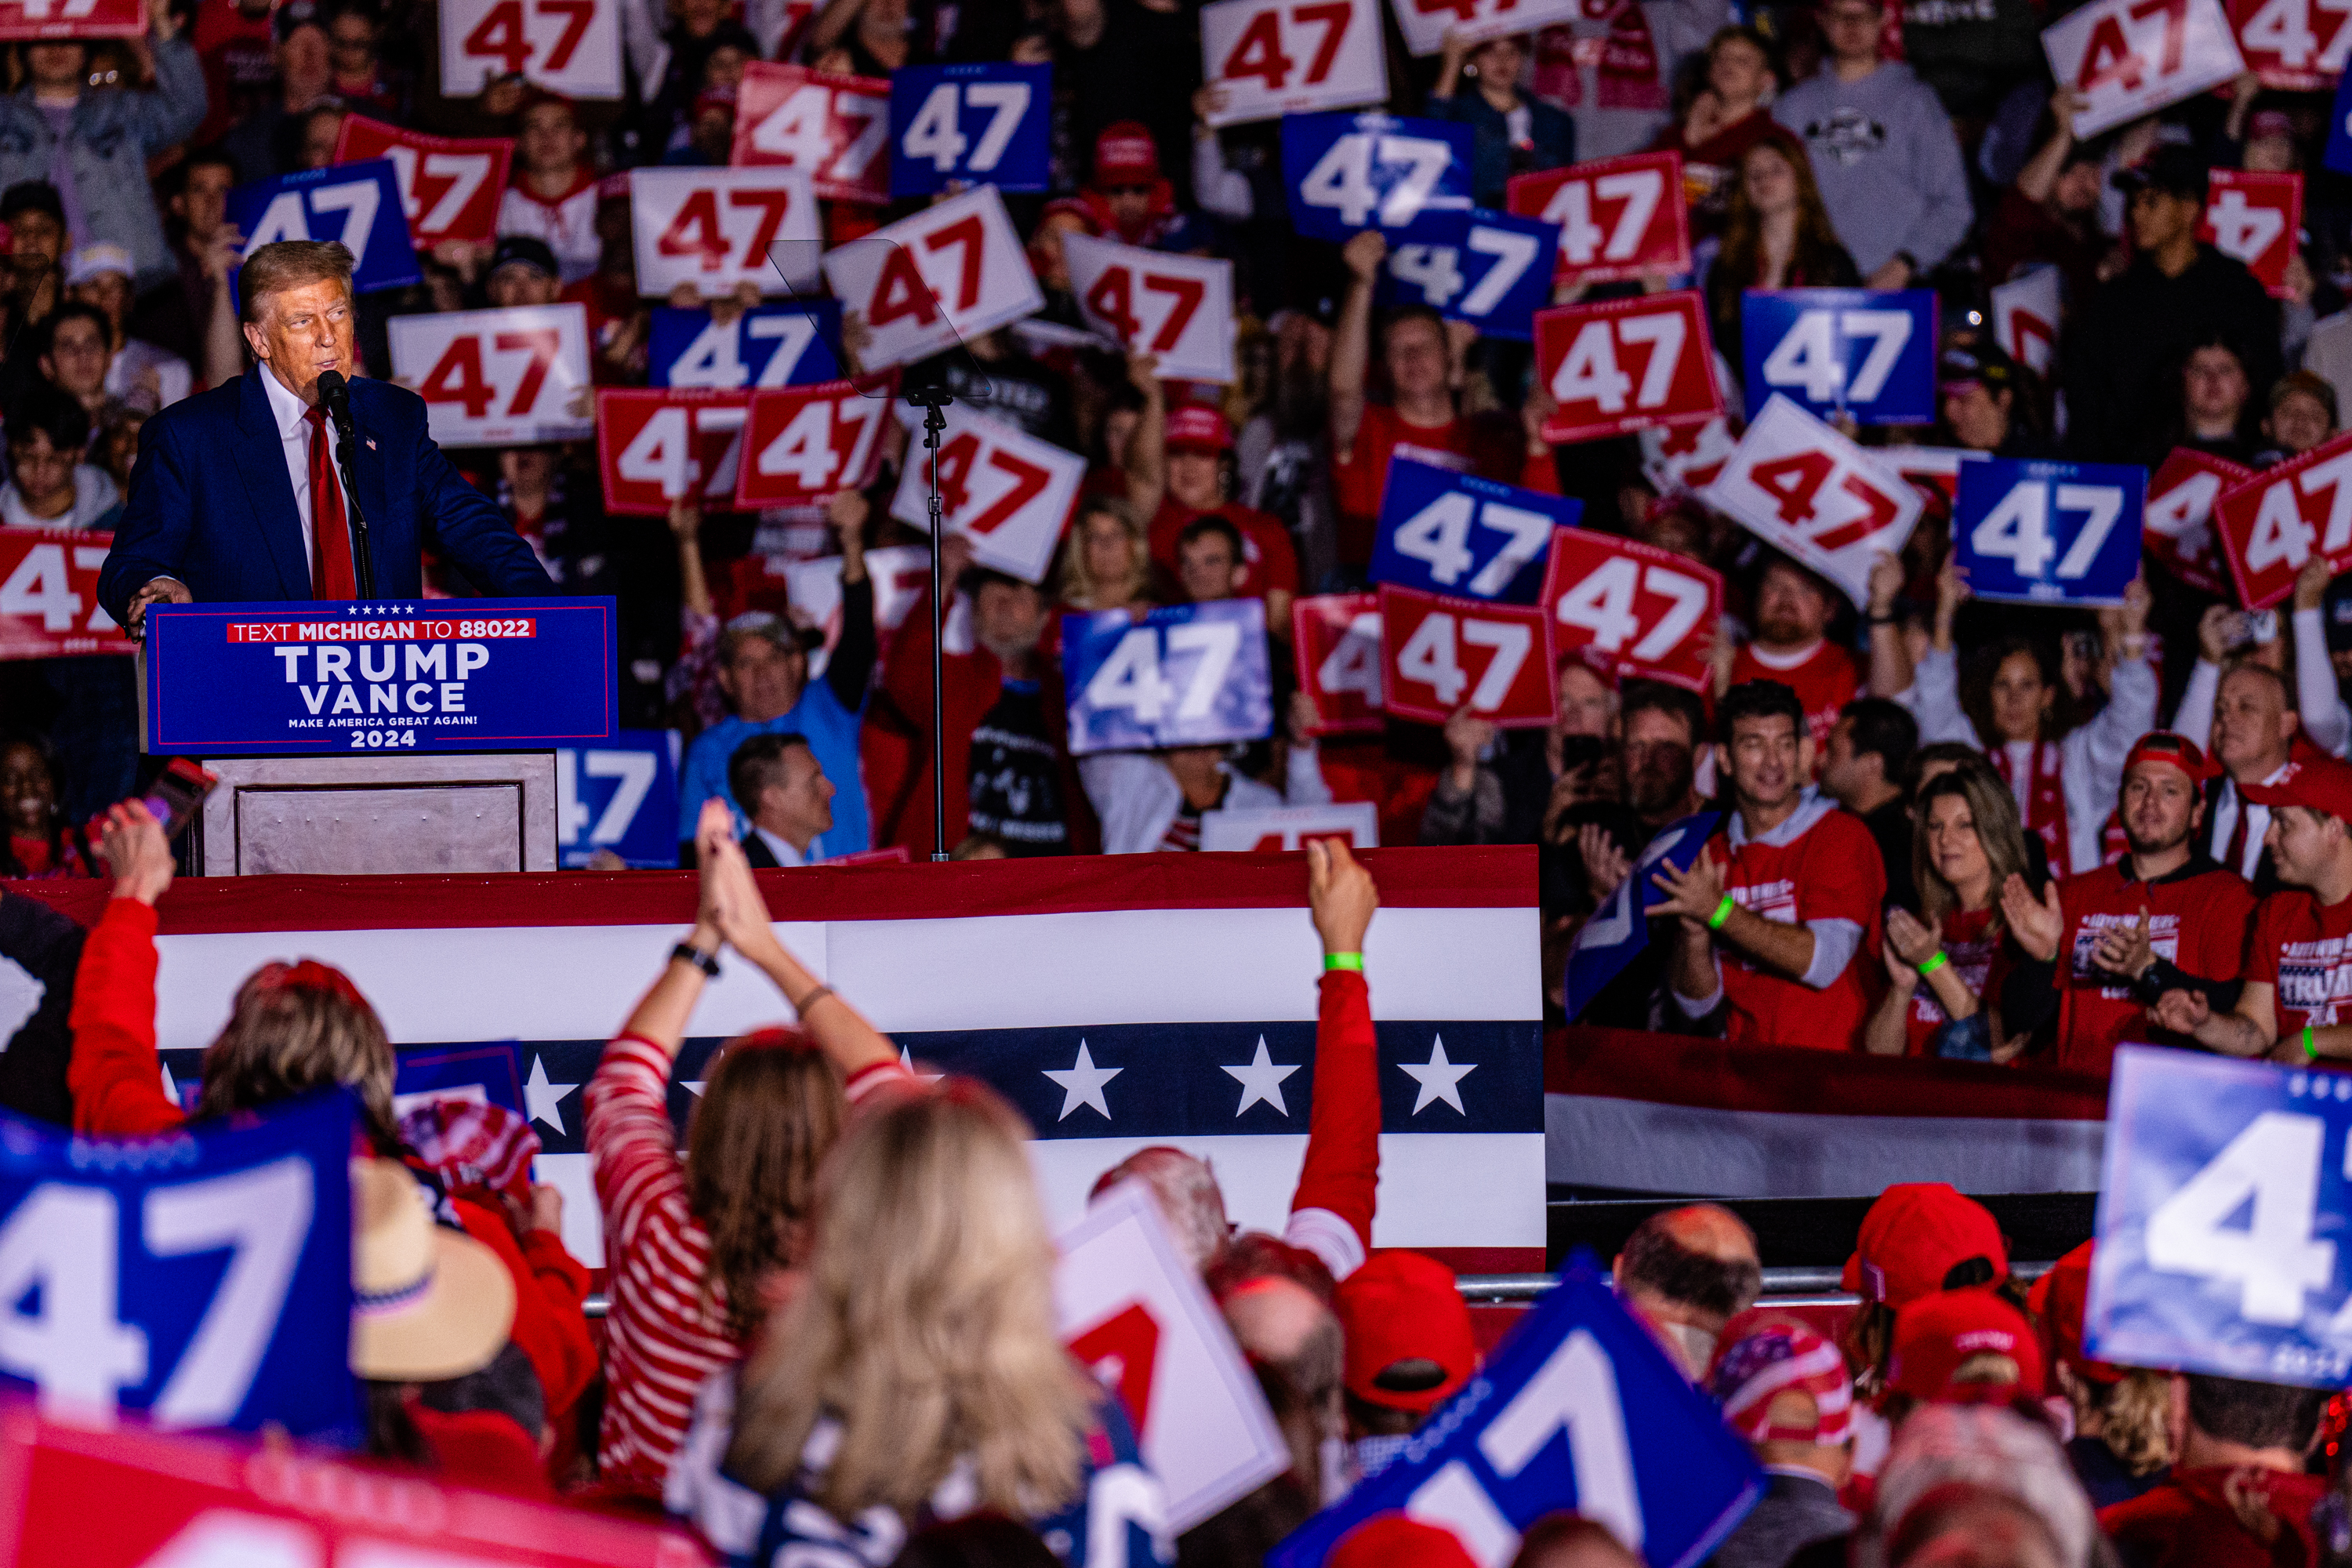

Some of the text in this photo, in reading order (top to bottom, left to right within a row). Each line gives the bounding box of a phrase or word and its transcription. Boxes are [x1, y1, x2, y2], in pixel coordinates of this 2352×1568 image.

[464, 1, 595, 72] 47
[1224, 3, 1351, 90] 47
[2078, 0, 2187, 89] 47
[753, 82, 891, 180] 47
[902, 82, 1031, 172] 47
[1301, 133, 1450, 227] 47
[1541, 169, 1663, 264] 47
[659, 190, 789, 272] 47
[869, 214, 985, 328] 47
[1389, 225, 1540, 315] 47
[669, 314, 818, 387] 47
[1089, 264, 1204, 353] 47
[422, 328, 560, 418] 47
[1551, 311, 1686, 413] 47
[1764, 310, 1913, 403] 47
[617, 405, 749, 501] 47
[759, 386, 889, 489] 47
[922, 432, 1051, 535] 47
[1394, 492, 1555, 596] 47
[1750, 448, 1899, 551] 47
[1971, 480, 2123, 579] 47
[2144, 471, 2222, 561] 4
[234, 620, 530, 641] TEXT MICHIGAN TO 88022
[1556, 556, 1709, 662] 47
[274, 644, 490, 683] TRUMP
[299, 683, 466, 714] VANCE
[1088, 622, 1241, 723] 47
[1318, 613, 1383, 706] 4
[1398, 612, 1530, 712] 47
[289, 719, 323, 728] MAKE
[328, 718, 384, 727] AMERICA
[389, 717, 429, 726] GREAT
[350, 730, 416, 748] 2024
[2145, 1112, 2352, 1326] 4
[0, 1154, 315, 1435] 47
